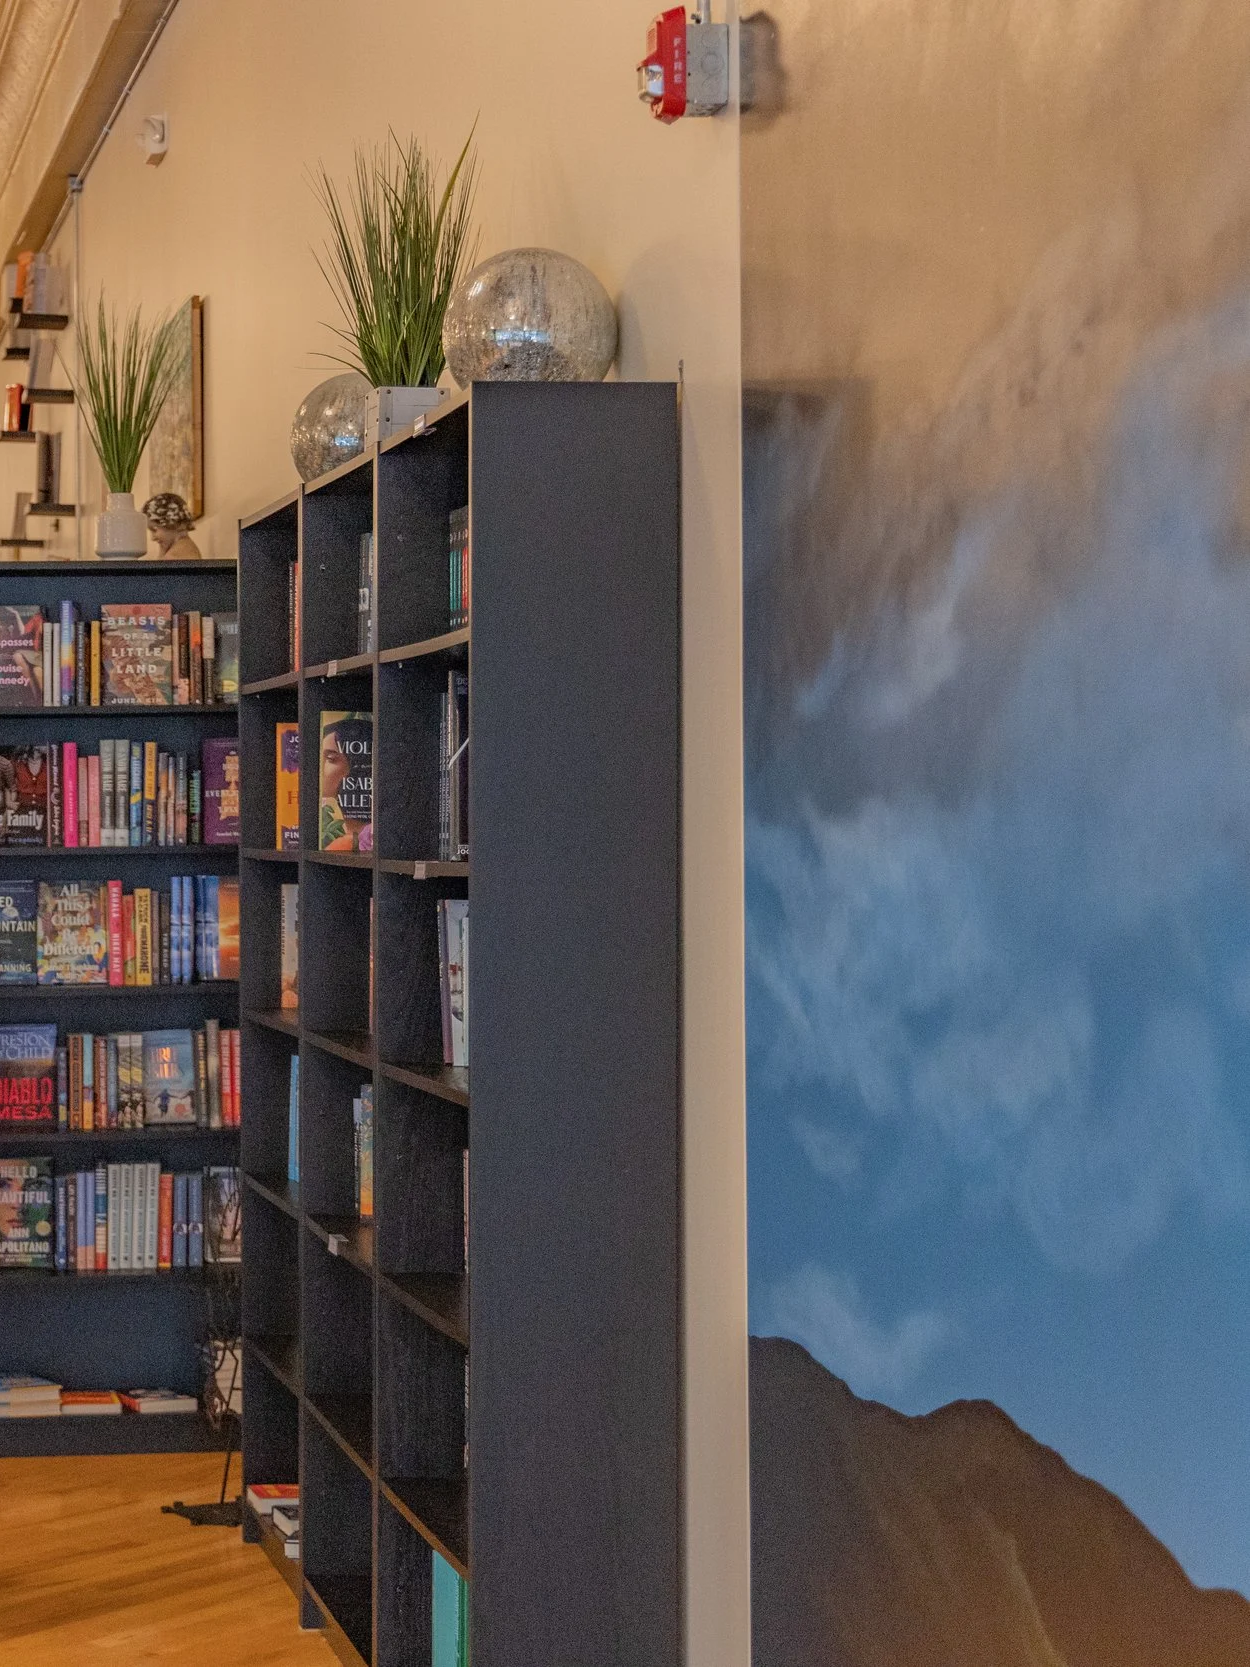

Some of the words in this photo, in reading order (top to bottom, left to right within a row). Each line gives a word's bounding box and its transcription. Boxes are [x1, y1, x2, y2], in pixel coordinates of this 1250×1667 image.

[673, 36, 684, 84] FIRE
[107, 616, 167, 626] BEASTS
[124, 632, 138, 640] OF
[140, 632, 150, 640] A
[111, 647, 162, 657] LITTLE
[116, 664, 158, 674] LAND
[7, 809, 44, 830] Family
[60, 883, 79, 897] All
[112, 887, 120, 918] WAHALA
[50, 912, 92, 926] Could
[43, 935, 99, 956] Different
[112, 933, 121, 956] NIKKI
[5, 1046, 52, 1060] CHILD
[0, 1165, 38, 1178] HELLO
[8, 1227, 30, 1239] ANN
